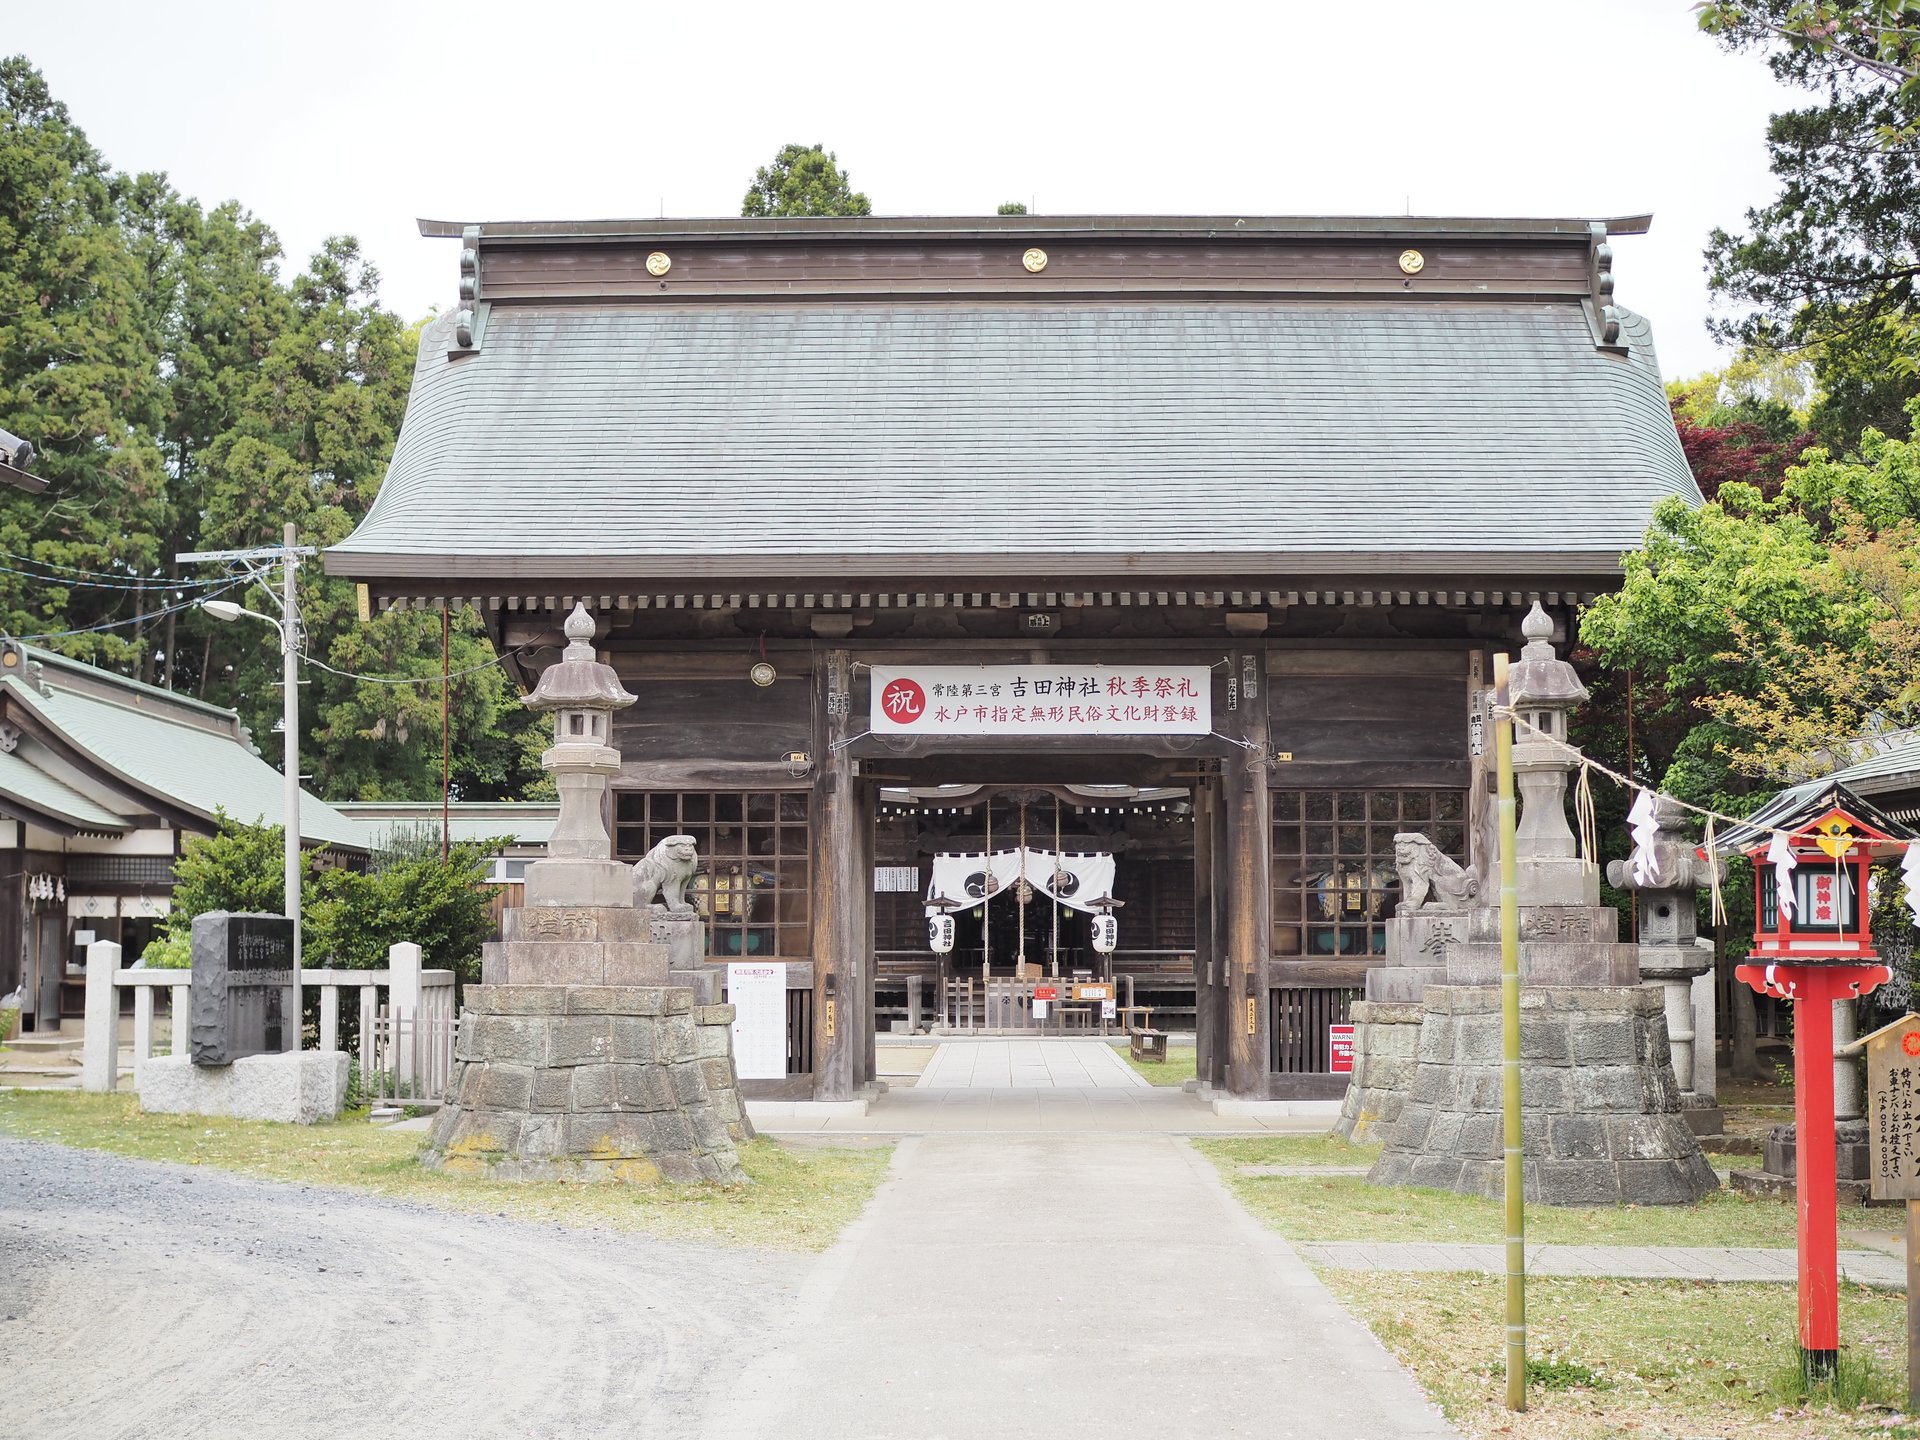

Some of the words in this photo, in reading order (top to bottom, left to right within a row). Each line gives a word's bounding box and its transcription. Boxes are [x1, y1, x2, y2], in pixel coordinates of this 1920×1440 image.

[886, 685, 920, 715] 祝
[932, 684, 1002, 698] 常陸第三宮
[1009, 676, 1101, 699] 吉田神社
[1106, 676, 1199, 699] 秋季祭礼
[933, 705, 1199, 724] 水戸市指定無形民俗文化財登録
[942, 918, 952, 947] 吉田神社
[1104, 918, 1115, 947] 吉田神社
